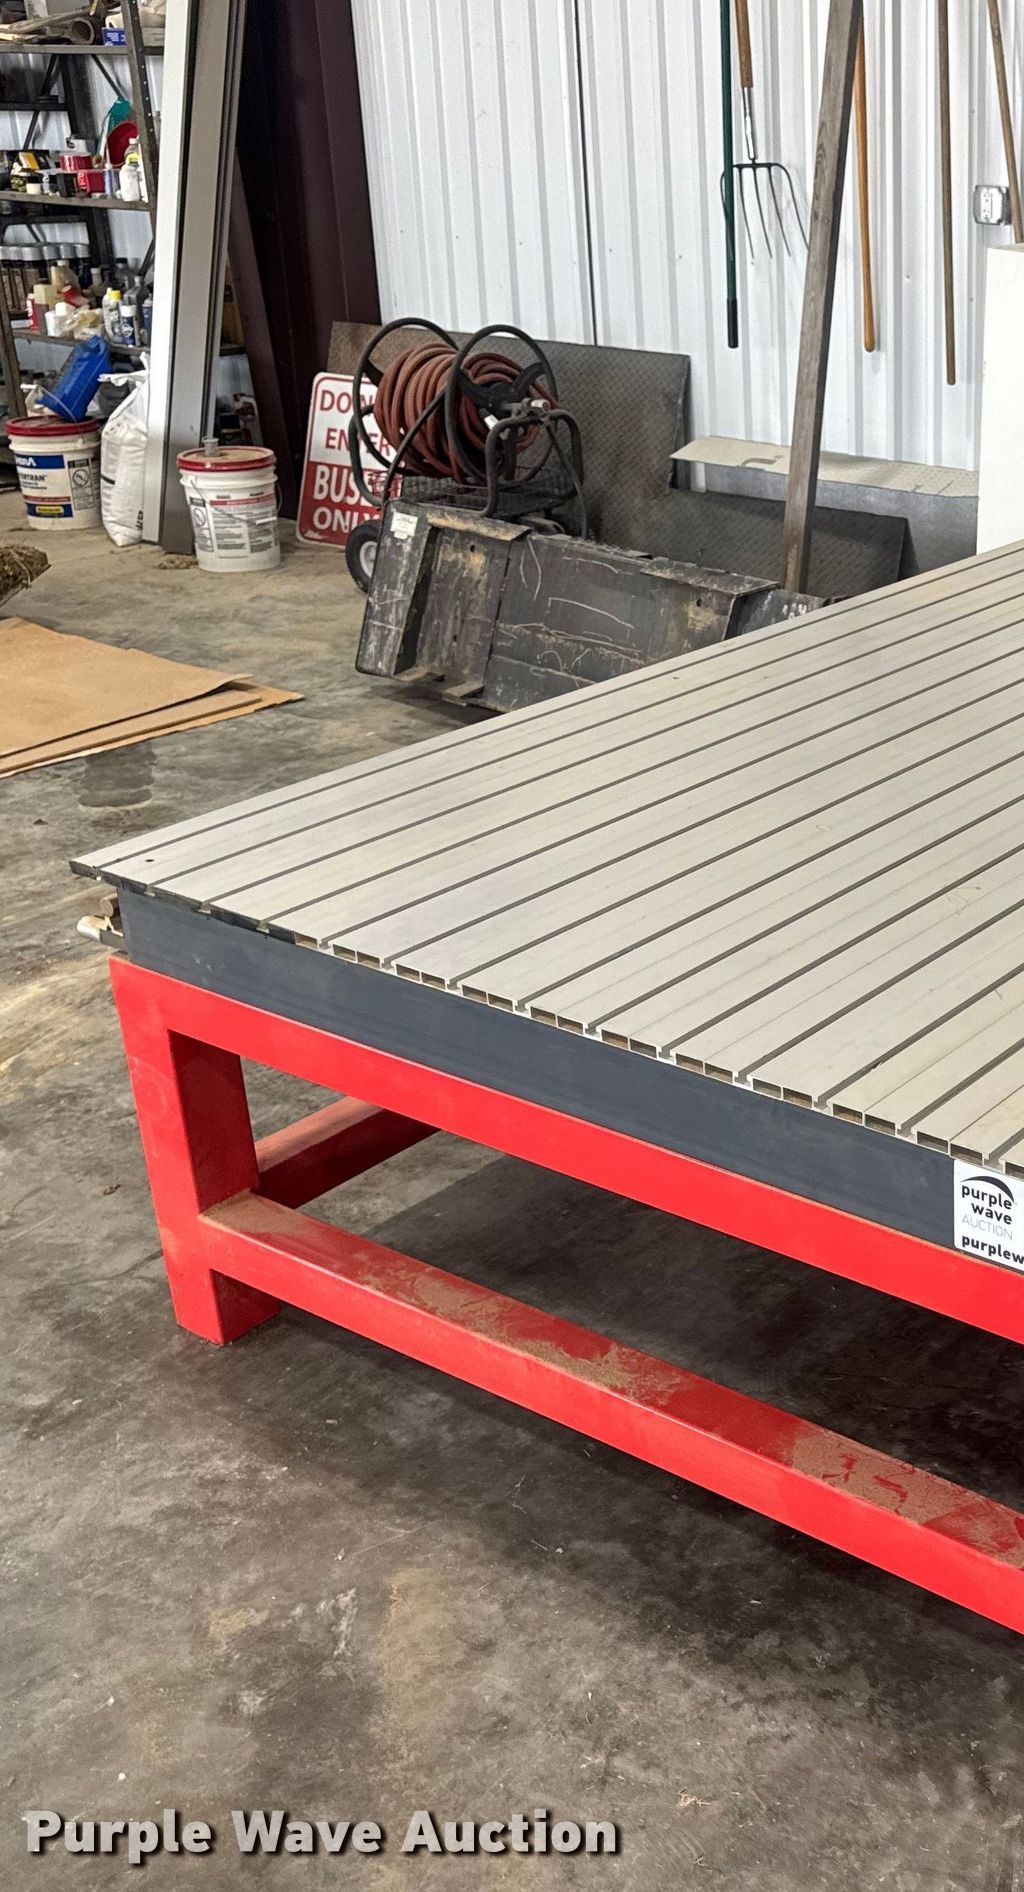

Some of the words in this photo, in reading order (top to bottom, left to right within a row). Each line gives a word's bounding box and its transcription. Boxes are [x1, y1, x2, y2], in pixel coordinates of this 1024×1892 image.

[320, 390, 352, 413] DO
[325, 427, 391, 456] ENER
[313, 507, 380, 534] ONL
[961, 1185, 1013, 1209] purple
[971, 1203, 1013, 1225] wave
[961, 1214, 1013, 1241] AUCTION
